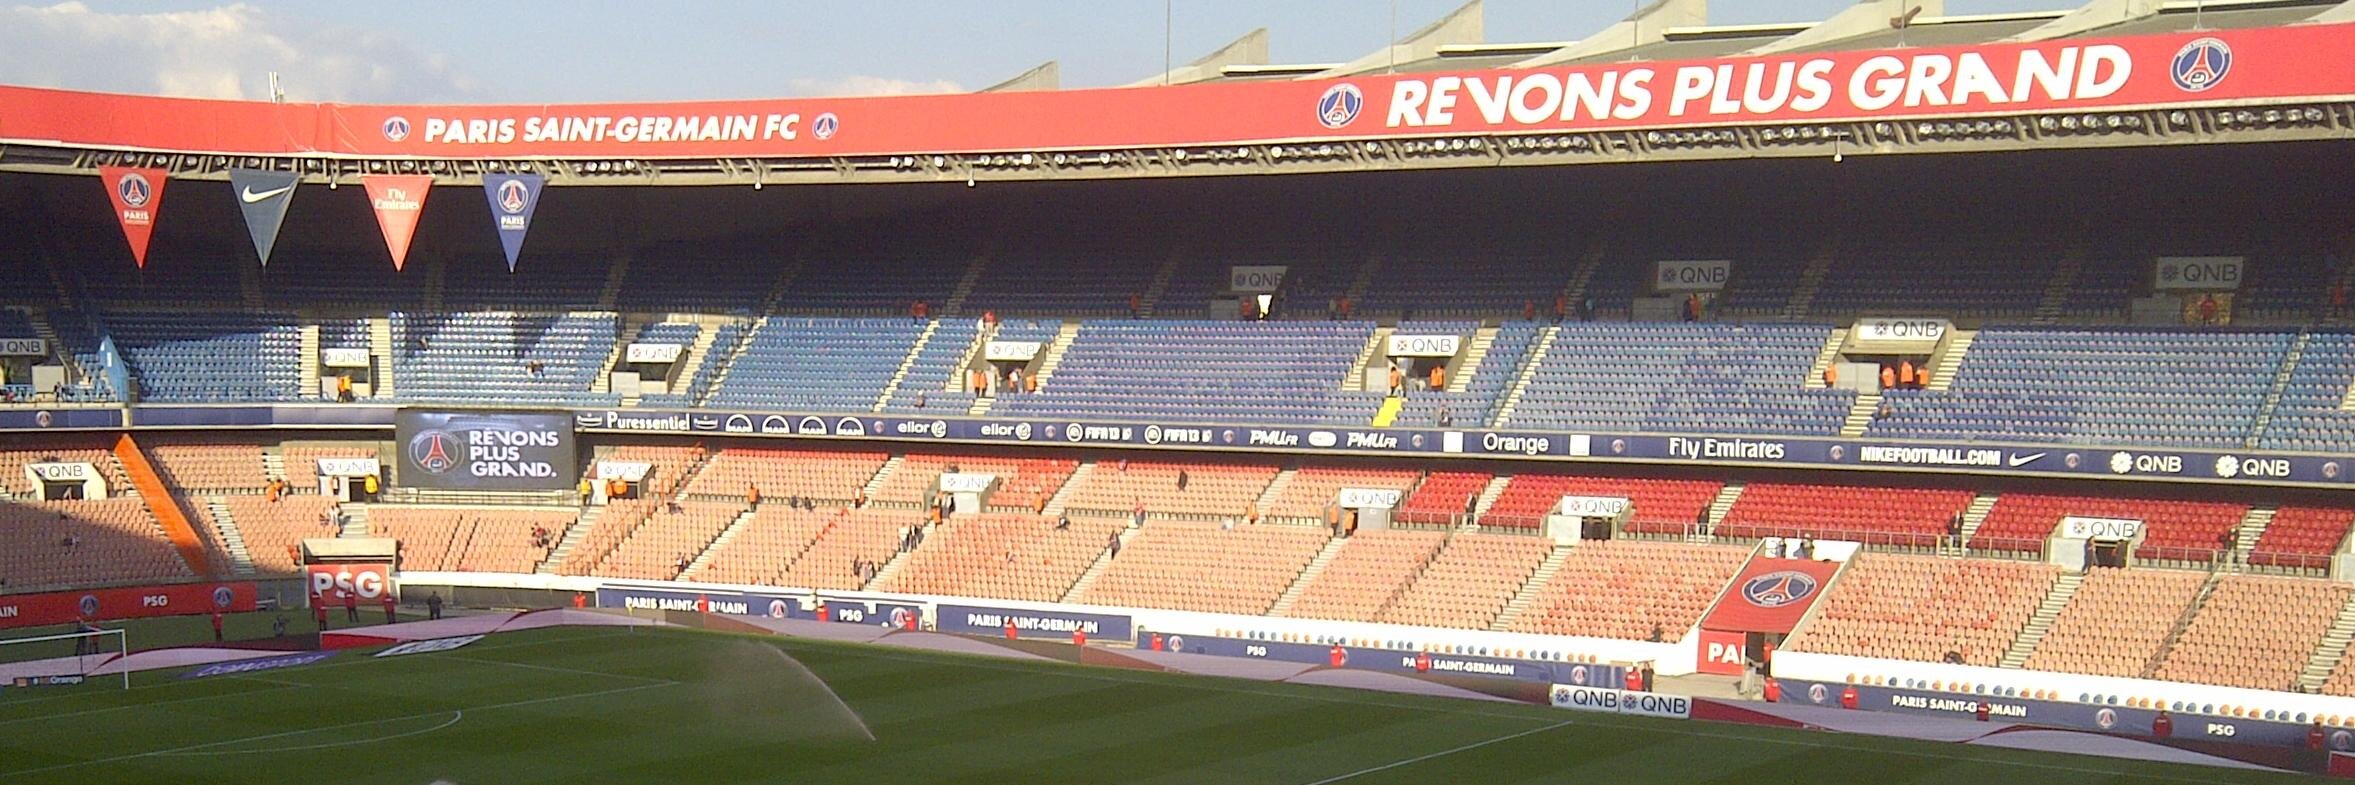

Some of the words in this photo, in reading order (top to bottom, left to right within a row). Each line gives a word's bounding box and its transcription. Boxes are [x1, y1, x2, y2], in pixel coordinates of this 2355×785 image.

[1668, 58, 1836, 117] PLUS
[1848, 43, 2133, 110] GRAND
[423, 116, 516, 144] PARIS
[522, 114, 756, 143] SAINT-GERMAIN
[763, 114, 801, 140] FC
[124, 210, 150, 220] PARIS
[500, 216, 525, 225] PARIS
[1680, 266, 1726, 283] QNB
[2183, 264, 2238, 281] QNB
[1893, 321, 1938, 337] QNB
[7, 341, 41, 352] QNB
[1412, 338, 1452, 352] QNB
[606, 411, 691, 430] Puressentiel
[1482, 432, 1550, 455] Orange
[1669, 437, 1700, 459] Fly
[1704, 438, 1785, 459] Emirates
[469, 446, 520, 462] PLUS
[1860, 446, 2001, 466] NIKEFOOTBALL.COM
[49, 465, 83, 477] QNB
[470, 461, 557, 478] GRAND.
[2136, 455, 2183, 473] QNB
[2242, 458, 2291, 477] QNB
[1585, 500, 1622, 513] QNB
[2091, 521, 2135, 537] QNB
[313, 571, 384, 599] PSG
[142, 595, 168, 607] PSG
[625, 596, 658, 609] PARIS
[839, 608, 863, 622] PSG
[967, 613, 1002, 627] PARIS
[1433, 659, 1515, 675] SAINT-GERMAIN
[1573, 689, 1617, 708] QNB
[1641, 695, 1687, 714] QNB
[1892, 695, 1927, 708] PARIS
[2207, 723, 2236, 736] PSG
